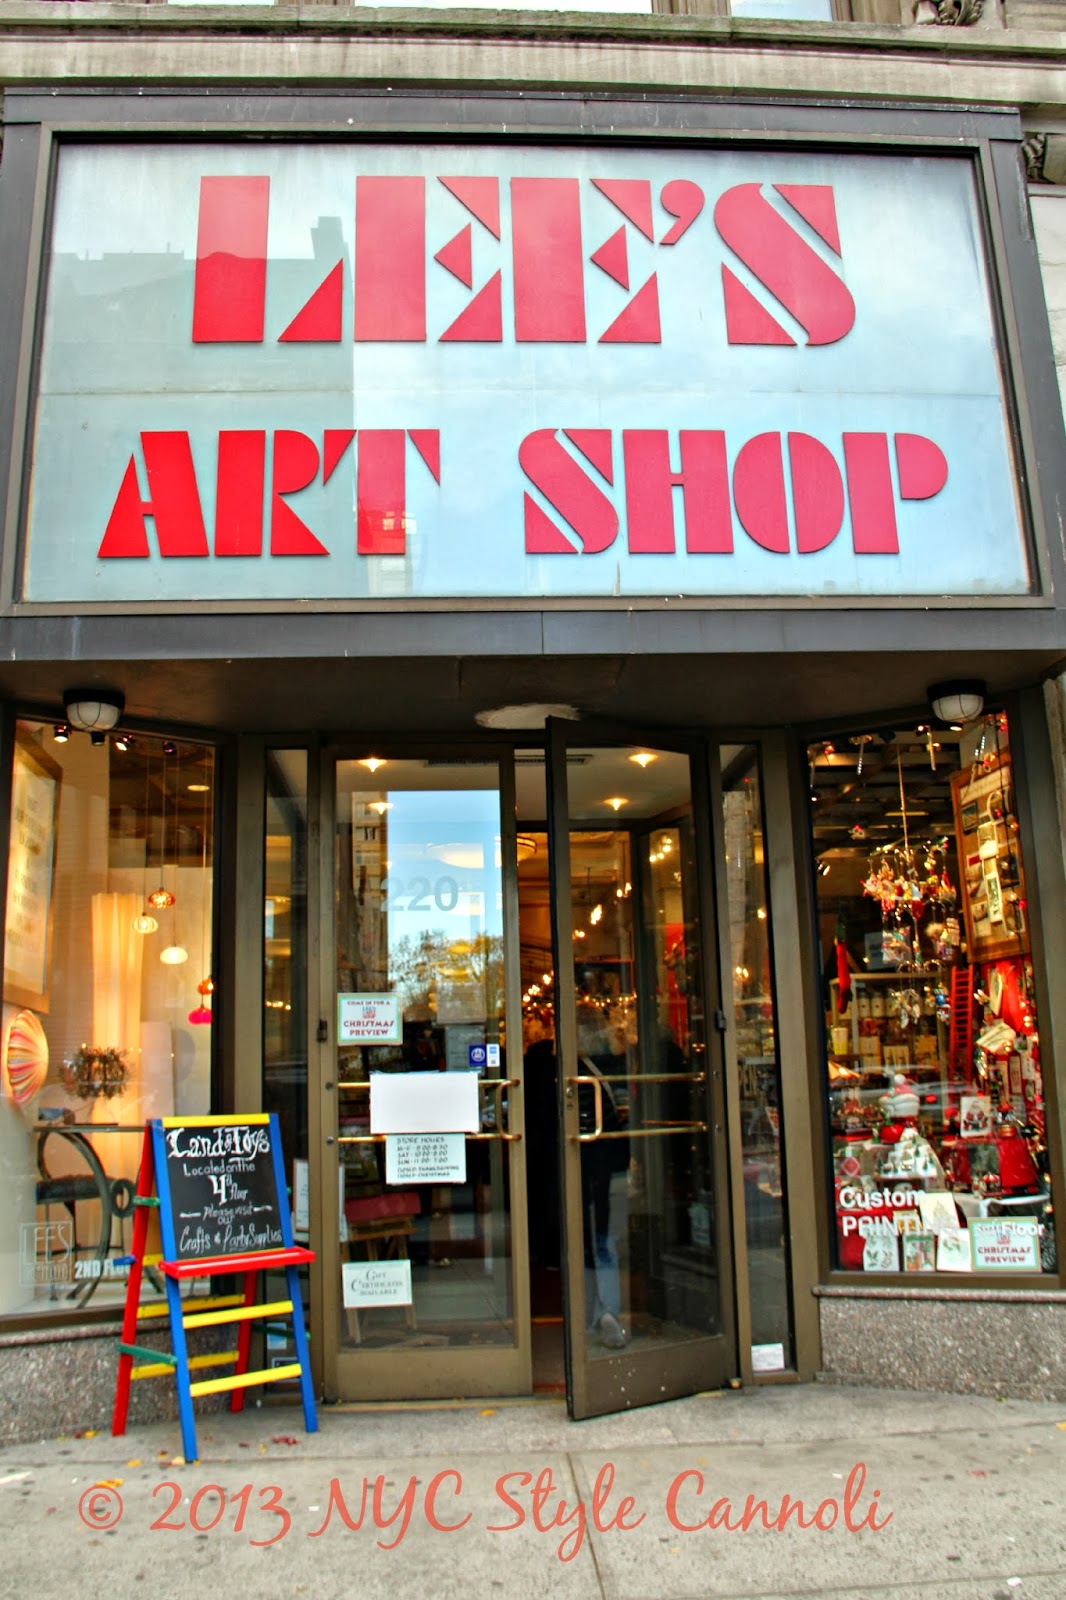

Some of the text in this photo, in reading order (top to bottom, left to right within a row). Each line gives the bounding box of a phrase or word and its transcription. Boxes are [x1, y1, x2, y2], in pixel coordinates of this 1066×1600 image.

[192, 175, 857, 346] LEE'S
[97, 427, 949, 559] ART SHOP
[380, 876, 459, 911] 220
[166, 1127, 226, 1159] Land
[225, 1126, 270, 1163] Toys
[840, 1186, 925, 1208] Custom
[977, 1246, 1031, 1254] CHRISTMAS
[75, 1259, 101, 1279] 2ND
